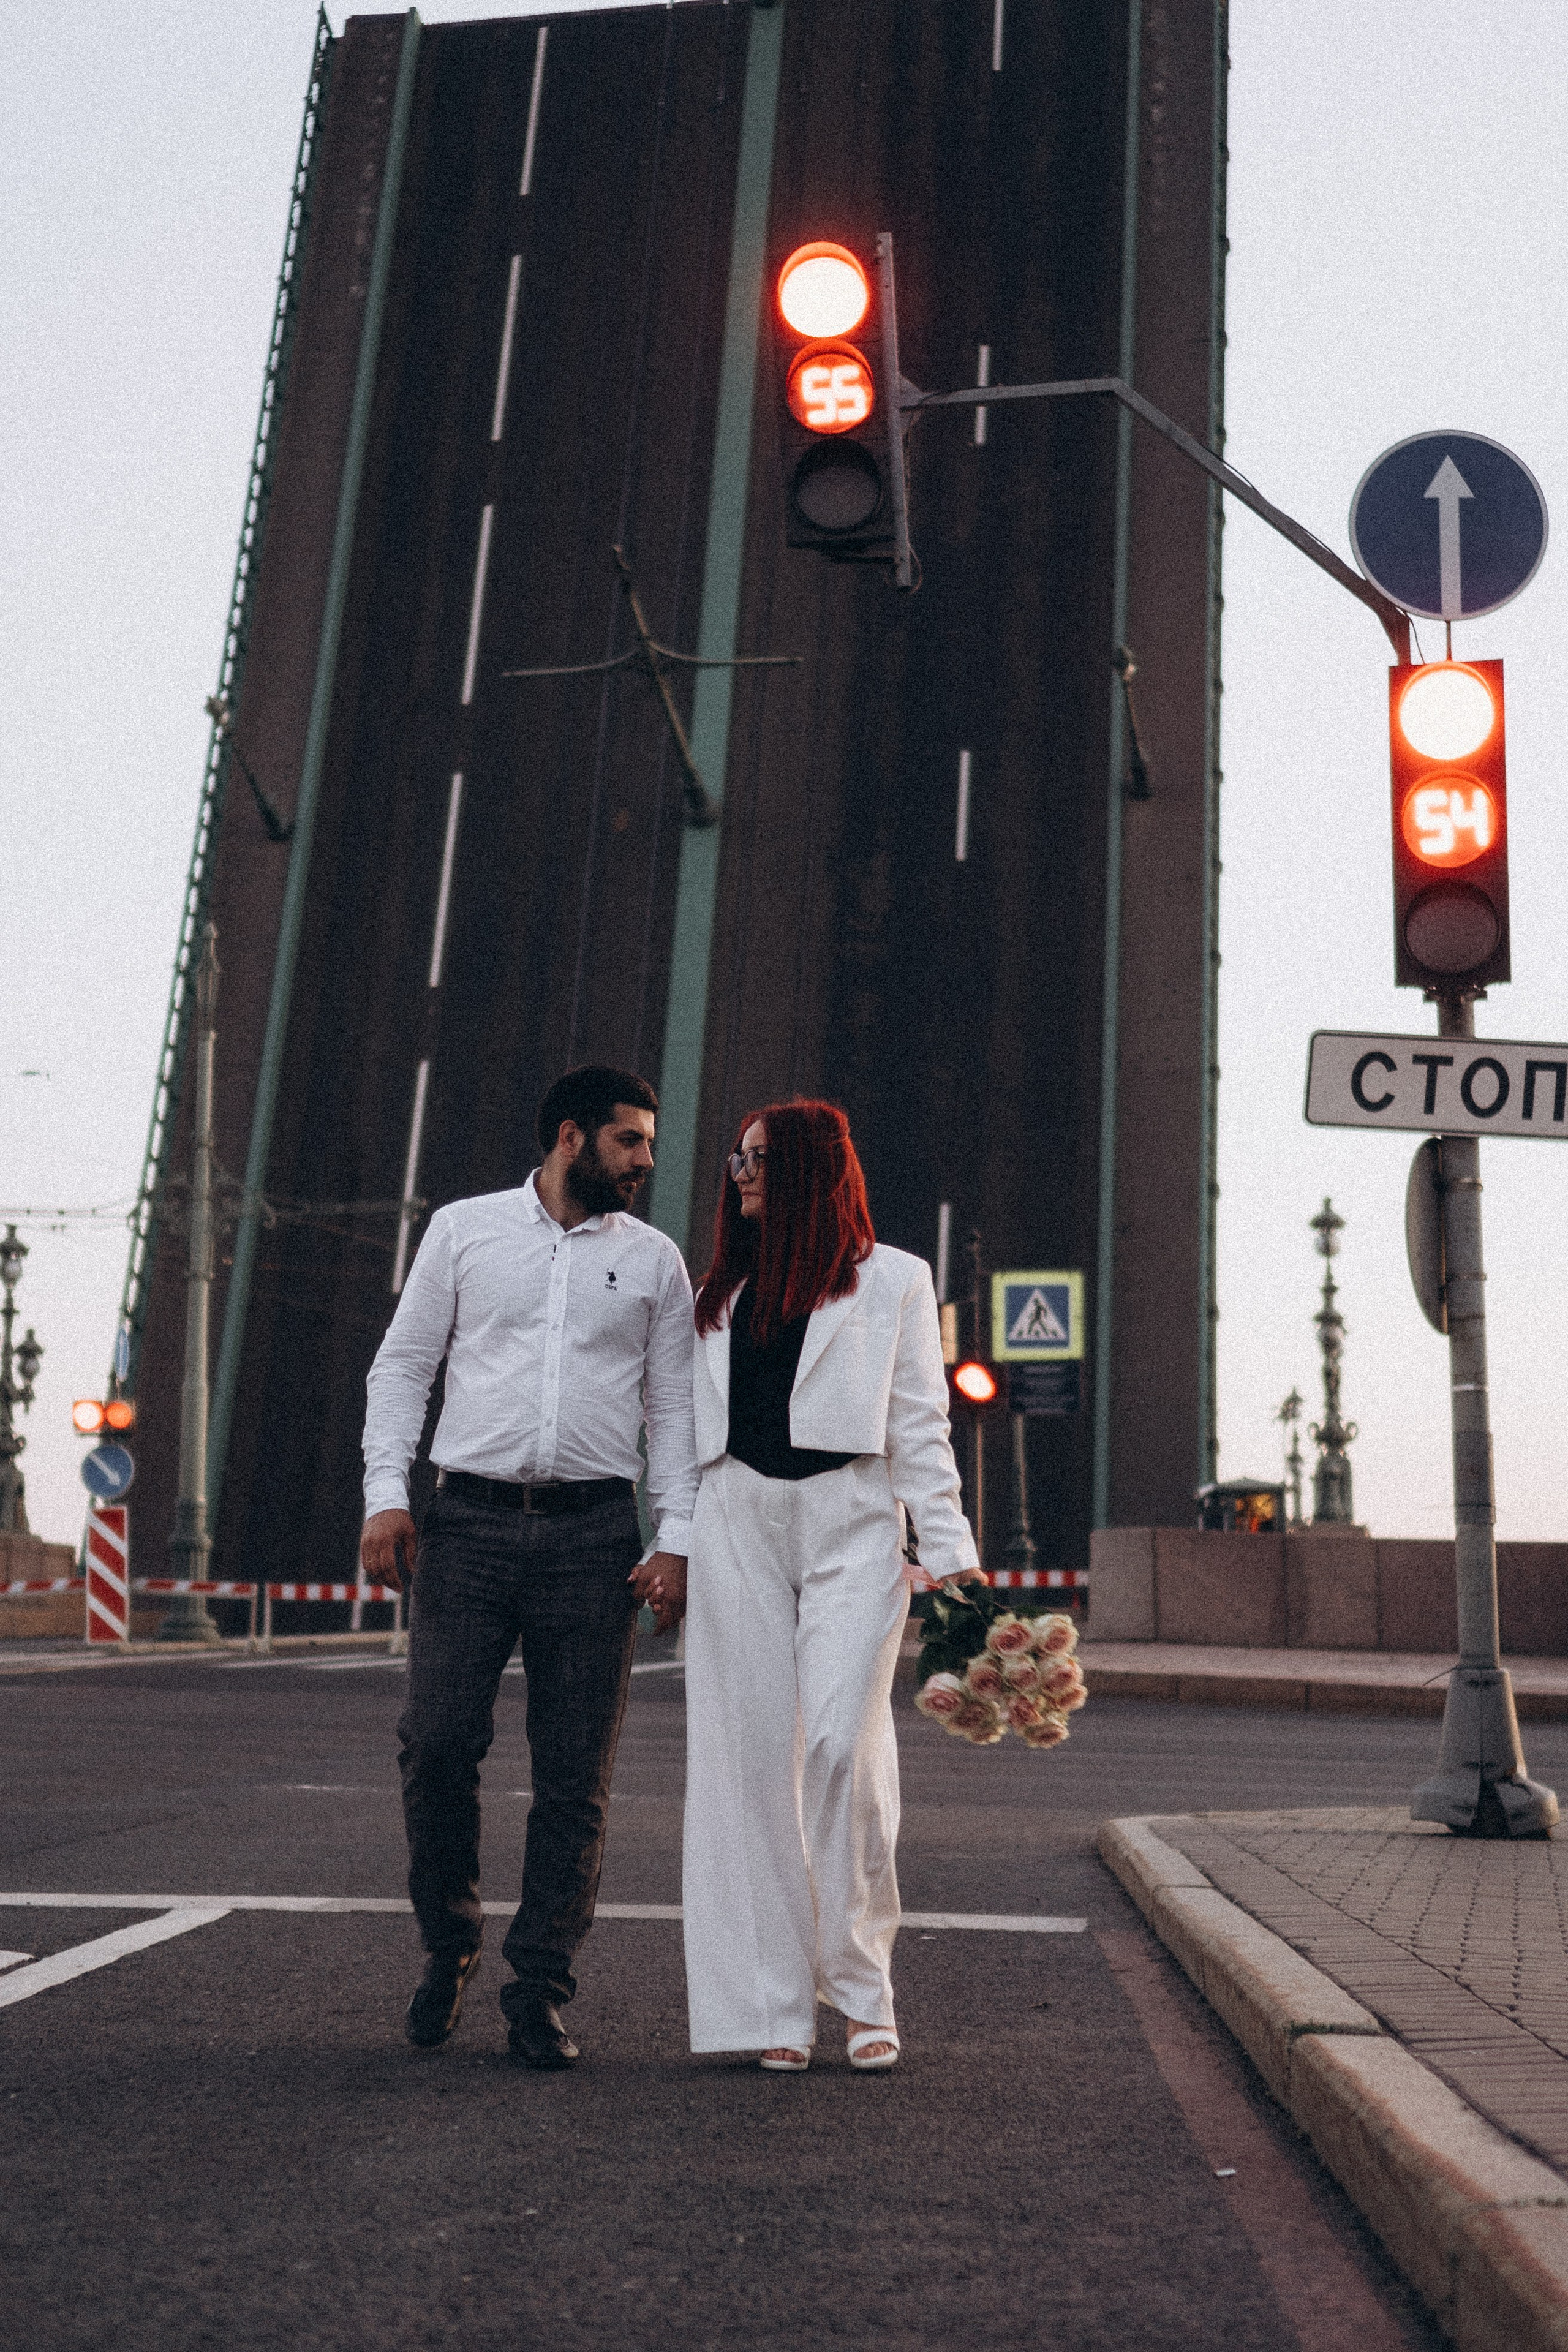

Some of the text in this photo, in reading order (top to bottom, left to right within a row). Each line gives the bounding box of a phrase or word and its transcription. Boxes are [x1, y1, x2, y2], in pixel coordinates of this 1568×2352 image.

[801, 364, 867, 424] 55
[1415, 788, 1490, 854] 54
[1351, 1051, 1567, 1122] СТОП
